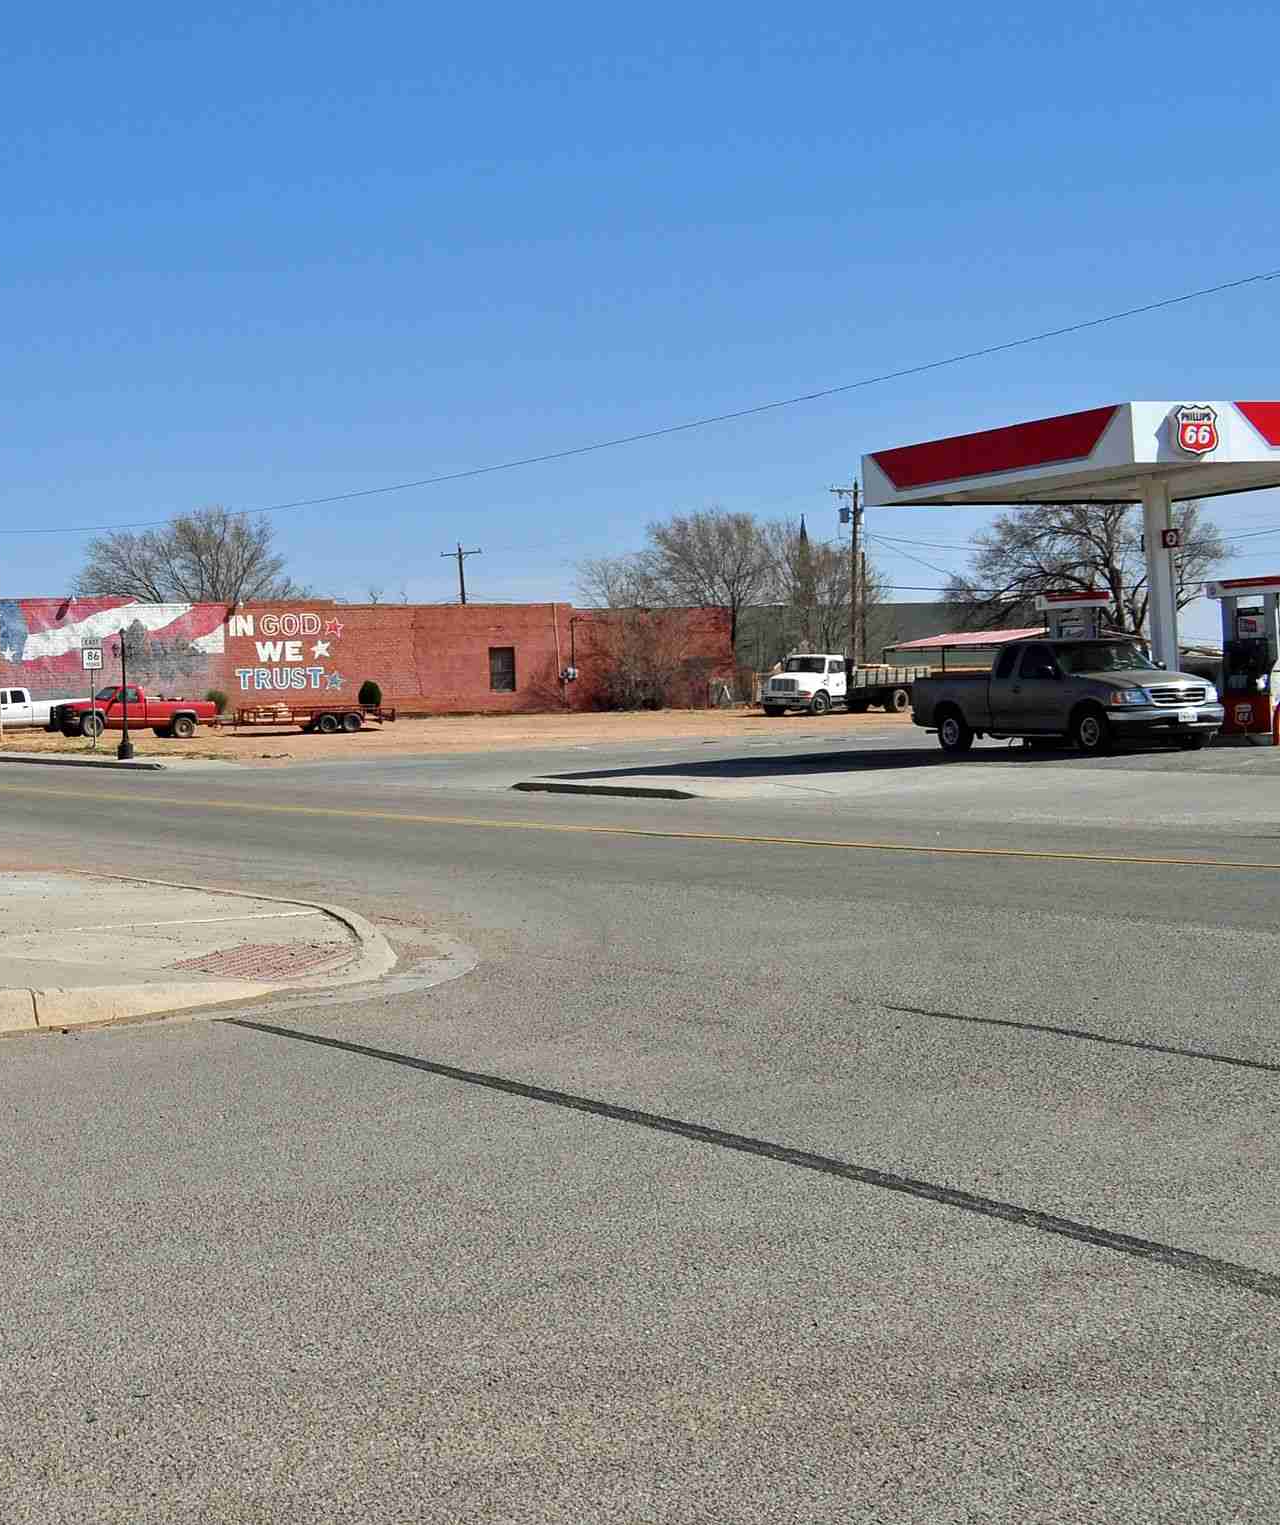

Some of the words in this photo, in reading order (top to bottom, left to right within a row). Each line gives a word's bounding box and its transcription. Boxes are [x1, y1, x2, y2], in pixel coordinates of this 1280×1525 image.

[1181, 412, 1211, 421] PHILLIPS
[1185, 425, 1211, 444] 66
[229, 614, 254, 637] IN
[260, 613, 321, 636] GOD
[87, 651, 100, 661] 86
[255, 640, 304, 662] WE
[235, 667, 324, 690] TRUST
